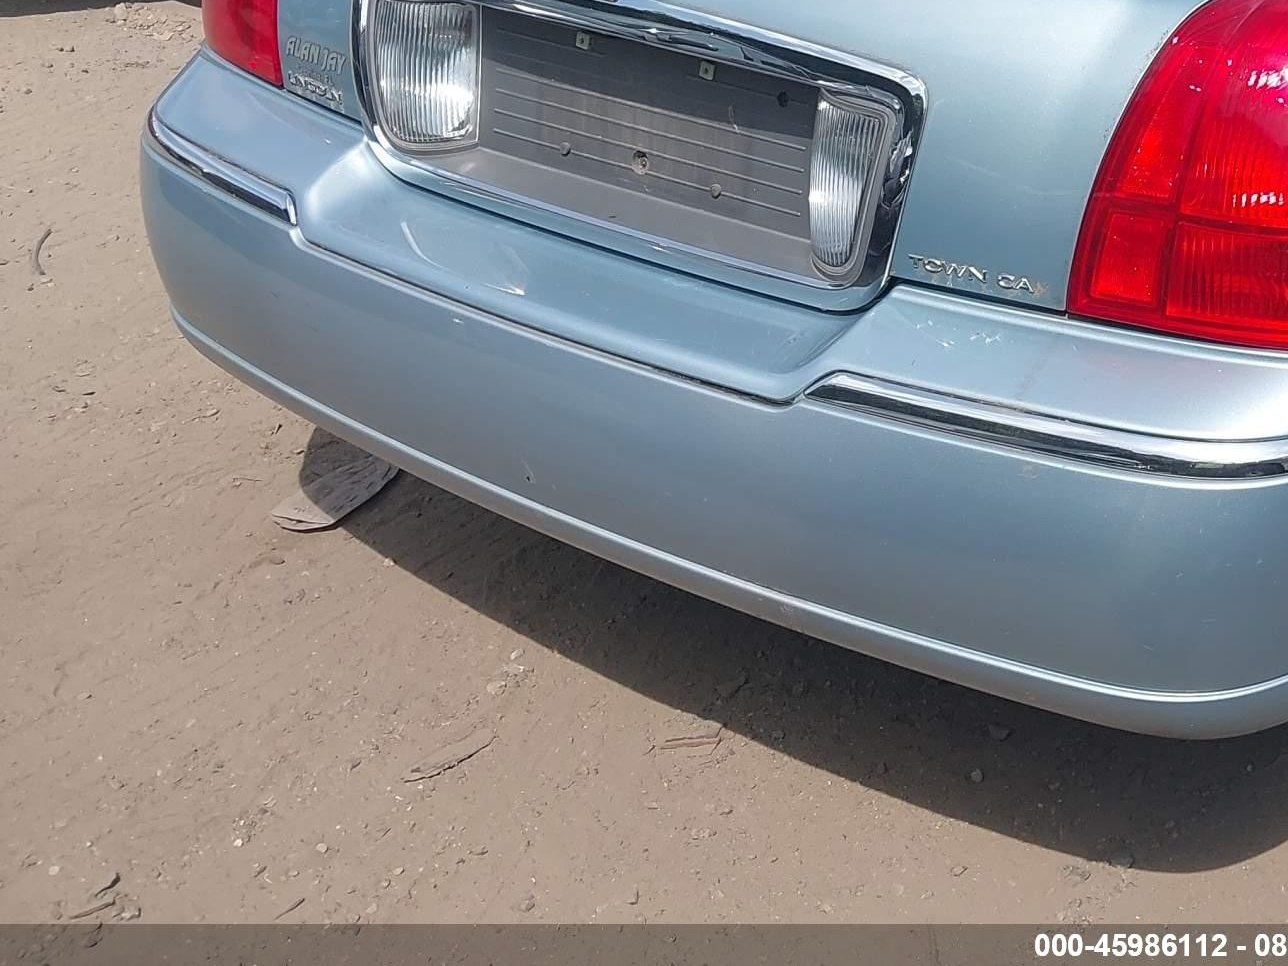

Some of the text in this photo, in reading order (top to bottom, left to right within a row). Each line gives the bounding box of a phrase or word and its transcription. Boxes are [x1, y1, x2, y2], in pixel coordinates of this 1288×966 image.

[286, 36, 321, 65] ALAN
[321, 48, 347, 75] JAY
[908, 253, 988, 284] TOWN
